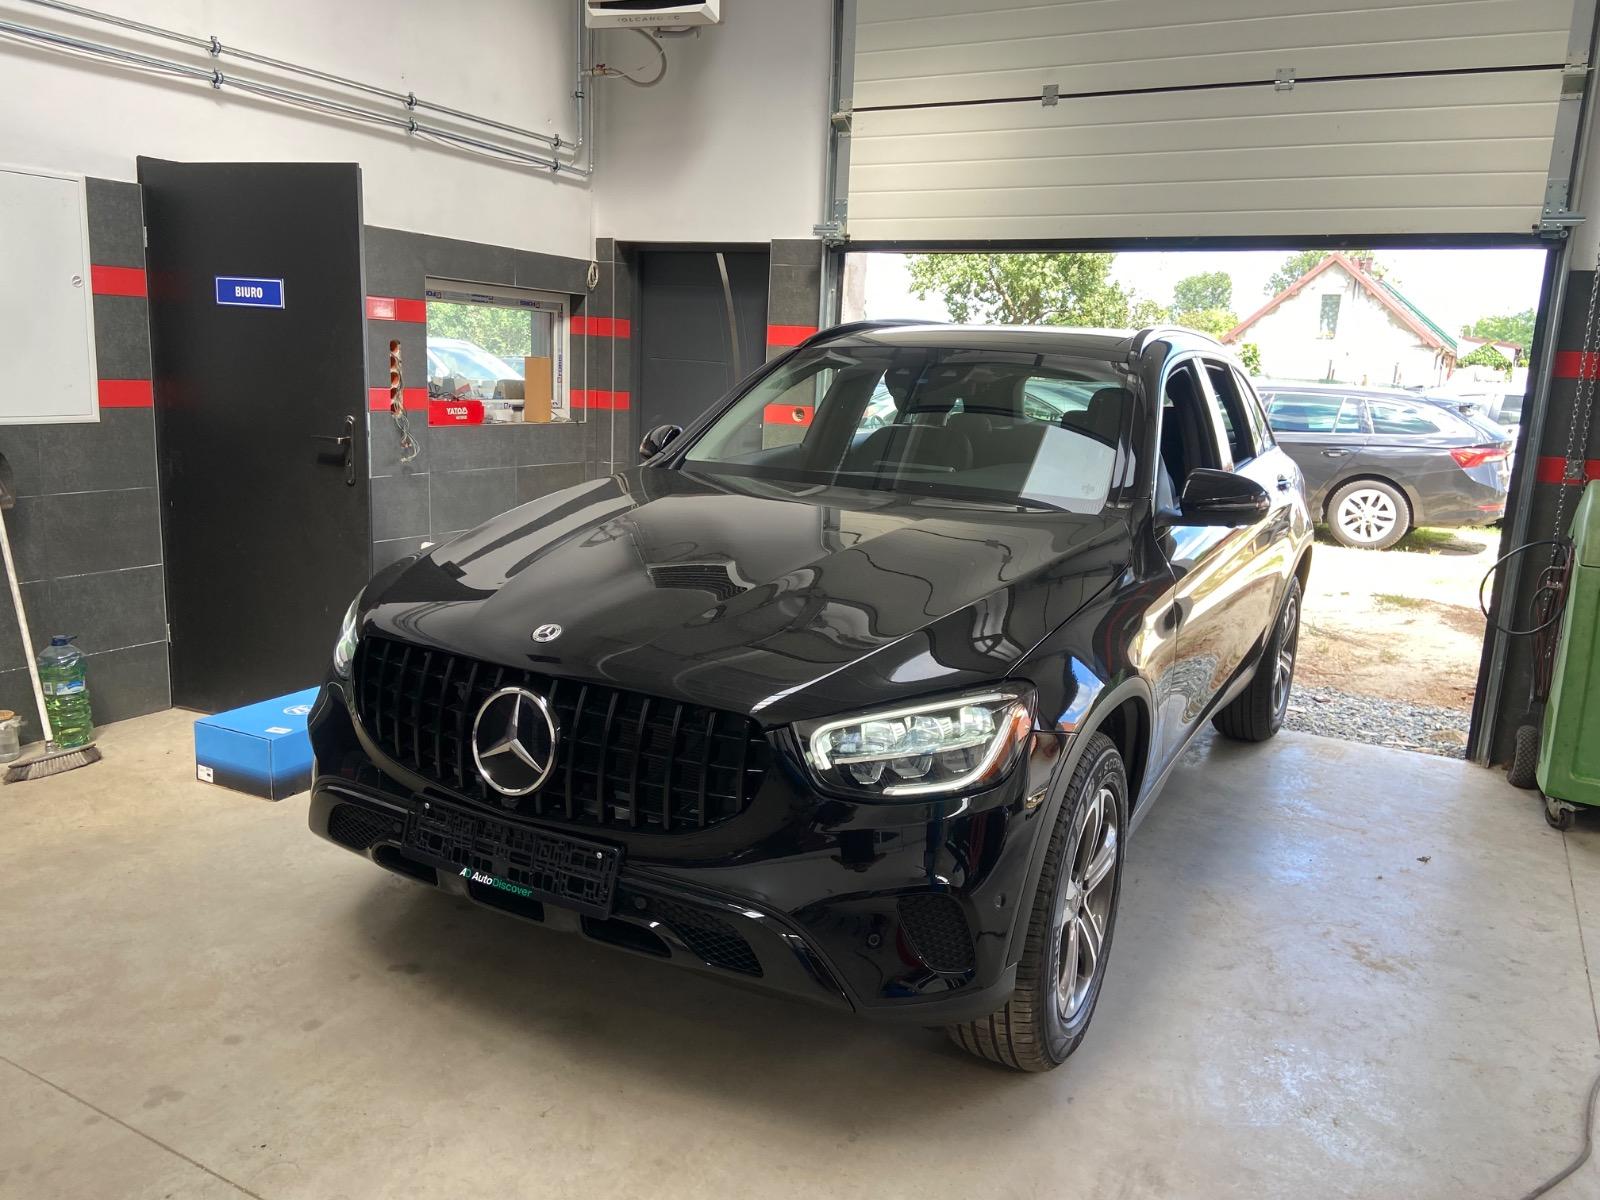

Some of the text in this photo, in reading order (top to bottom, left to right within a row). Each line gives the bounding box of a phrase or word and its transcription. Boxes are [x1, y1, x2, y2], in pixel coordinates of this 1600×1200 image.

[235, 286, 263, 298] BIURO
[446, 407, 464, 415] YATO
[459, 867, 532, 897] AD AutoDiscover
